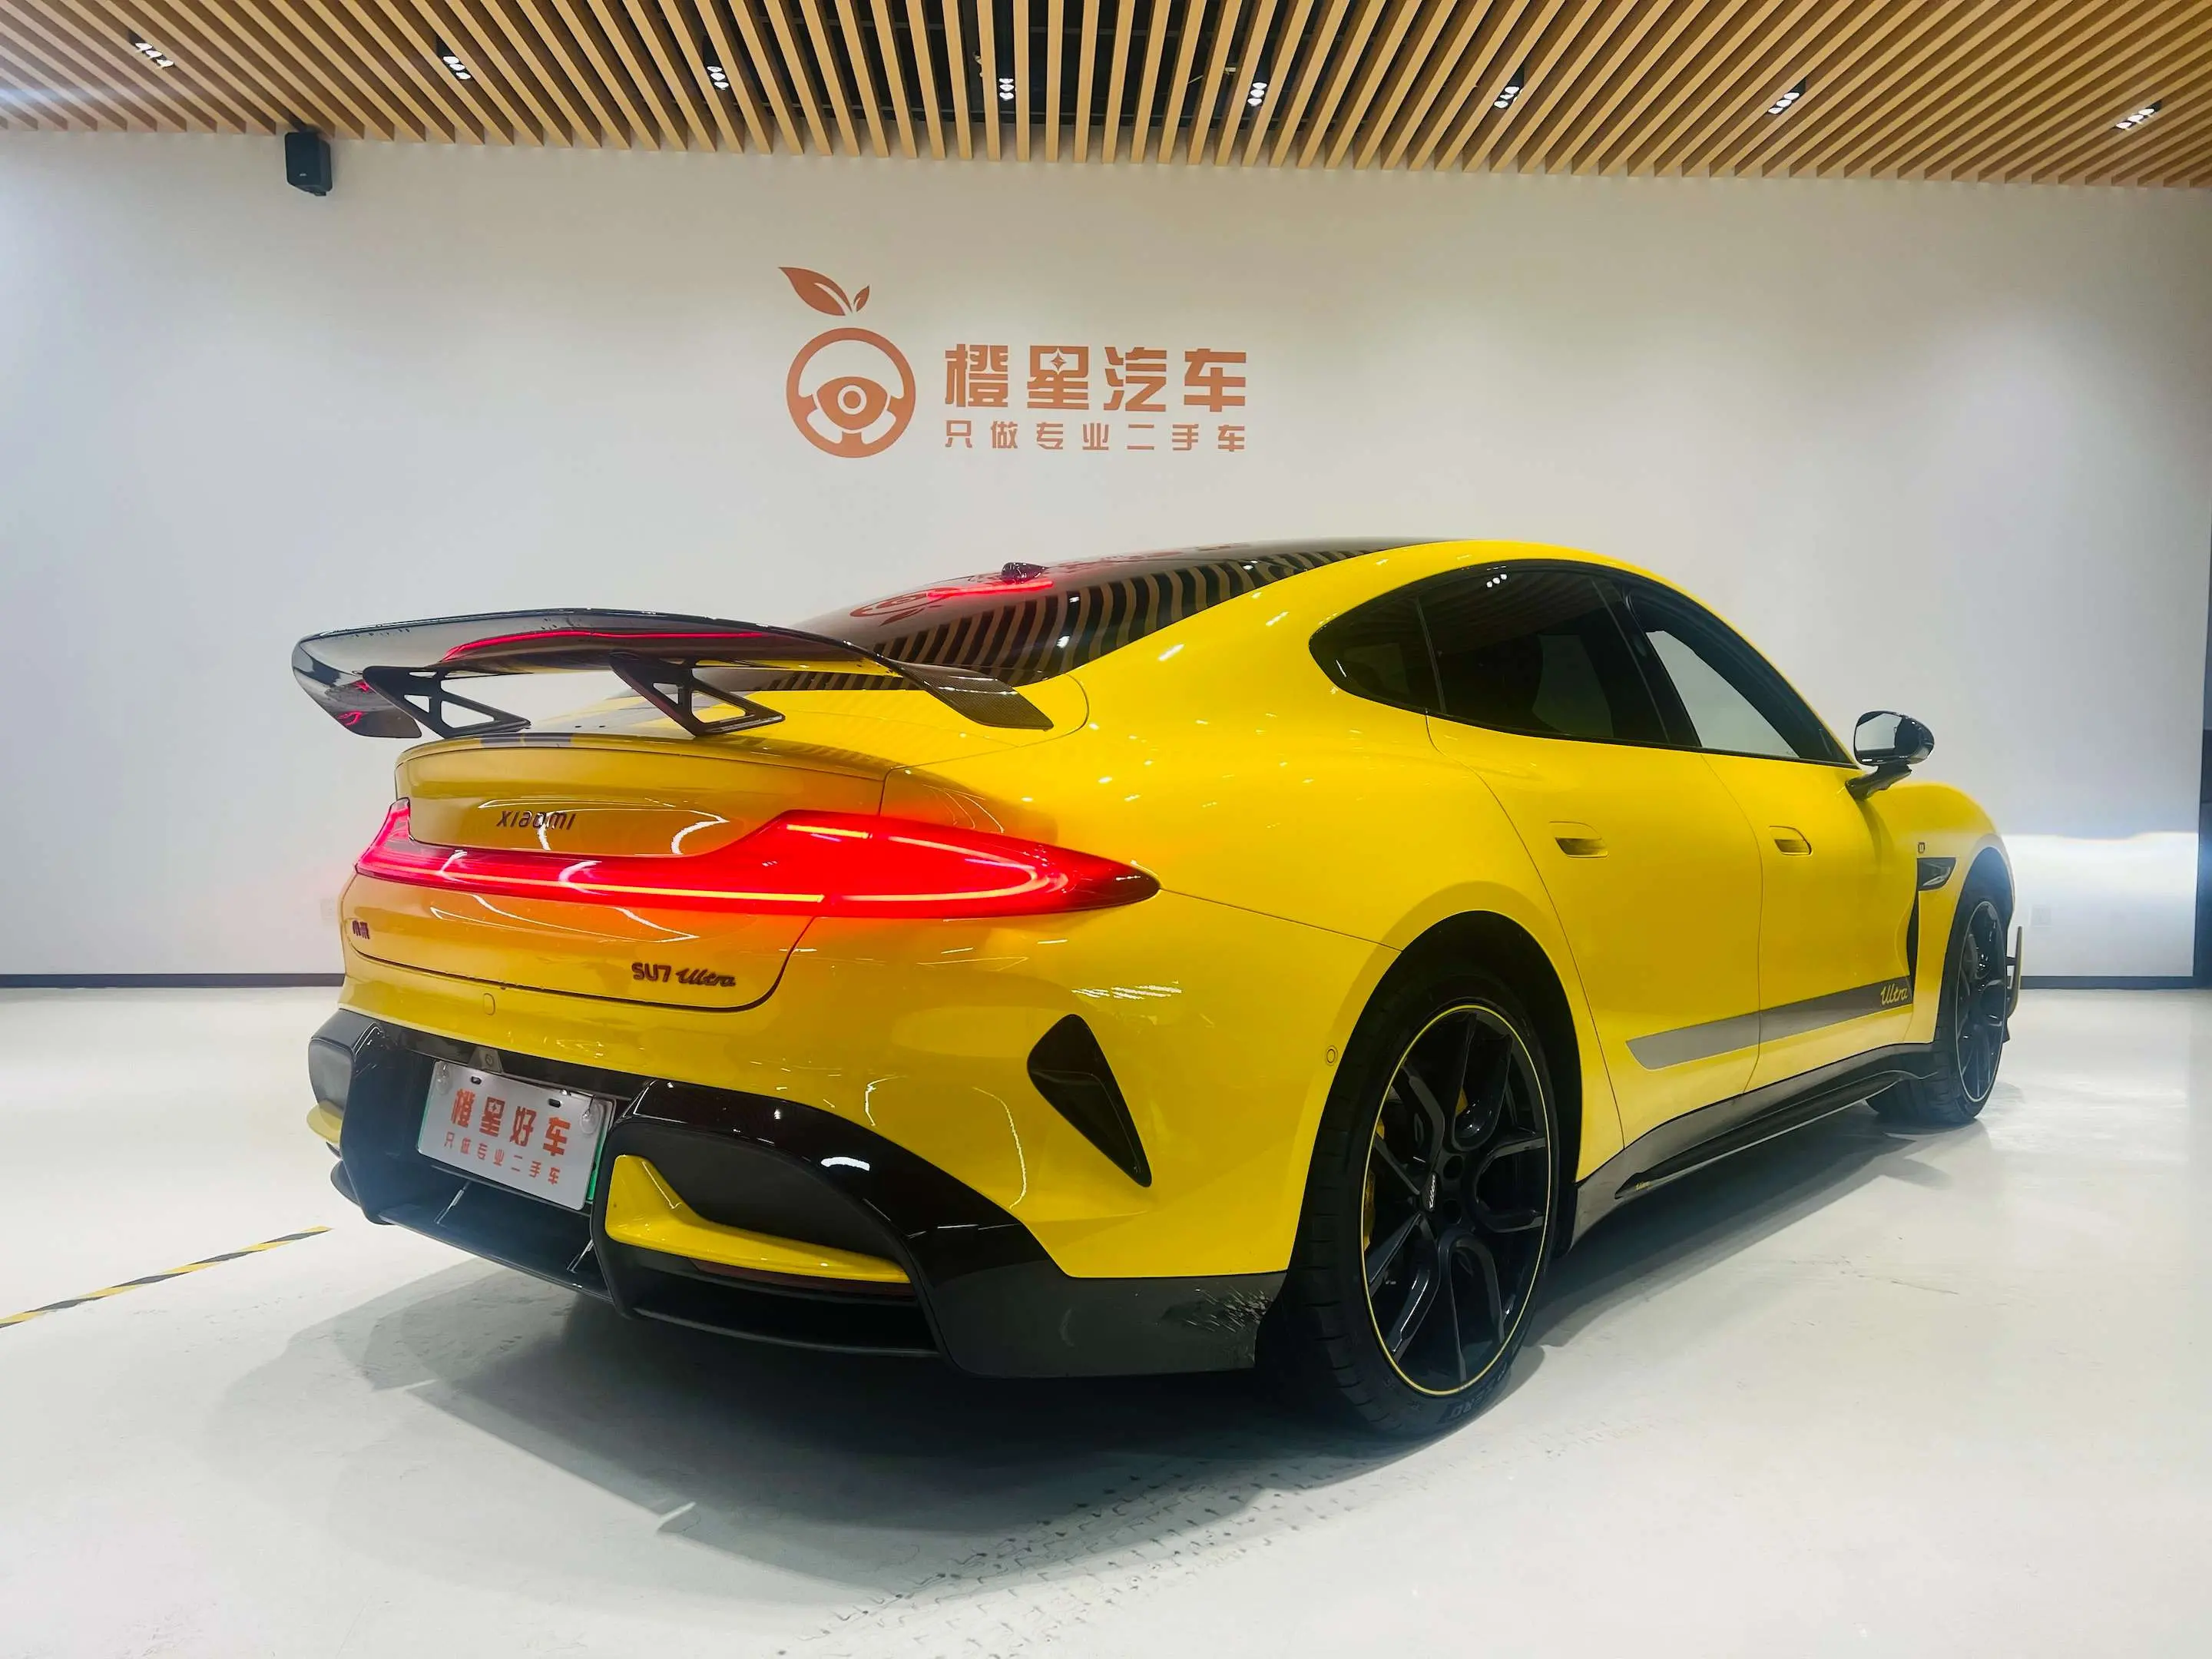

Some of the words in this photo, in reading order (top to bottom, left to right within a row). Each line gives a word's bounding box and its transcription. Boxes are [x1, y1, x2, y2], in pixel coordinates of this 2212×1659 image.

[945, 343, 1247, 412] 橙星汽车
[945, 419, 1245, 452] 只做专业二手车
[631, 962, 671, 983] SU7
[675, 968, 737, 988] Ultra
[1879, 982, 1909, 1005] Ultra
[450, 1087, 571, 1157] 橙星好车
[444, 1131, 561, 1185] 只做专业二手车
